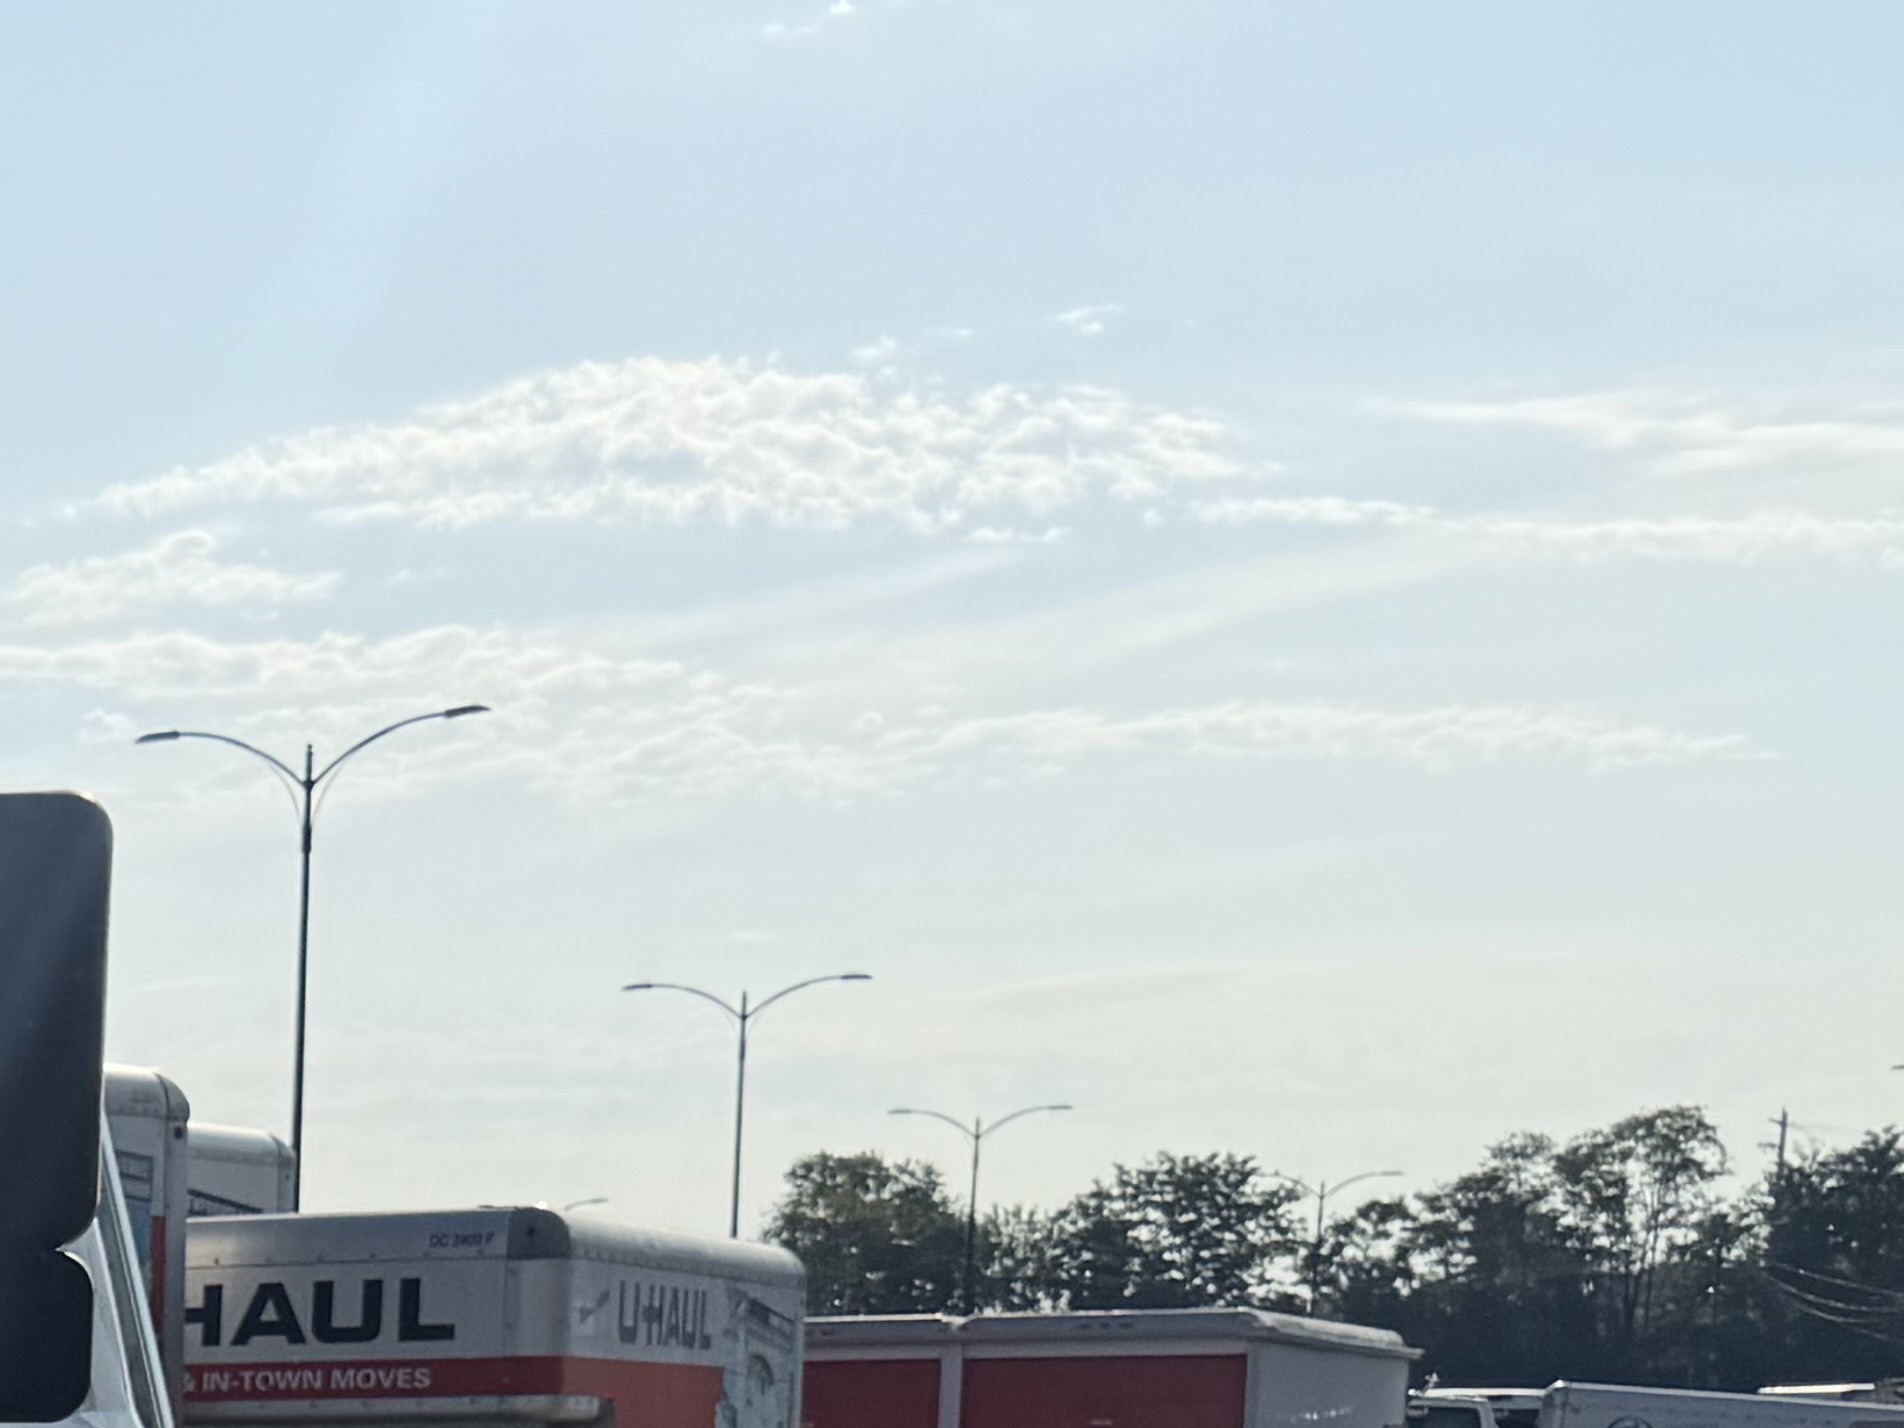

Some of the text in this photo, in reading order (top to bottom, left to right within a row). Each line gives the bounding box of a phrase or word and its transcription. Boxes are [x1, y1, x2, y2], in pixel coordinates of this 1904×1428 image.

[185, 1277, 455, 1346] HAUL
[618, 1279, 711, 1349] U-HAUL
[202, 1370, 323, 1393] IN-TOWN
[330, 1367, 432, 1390] MOVES
